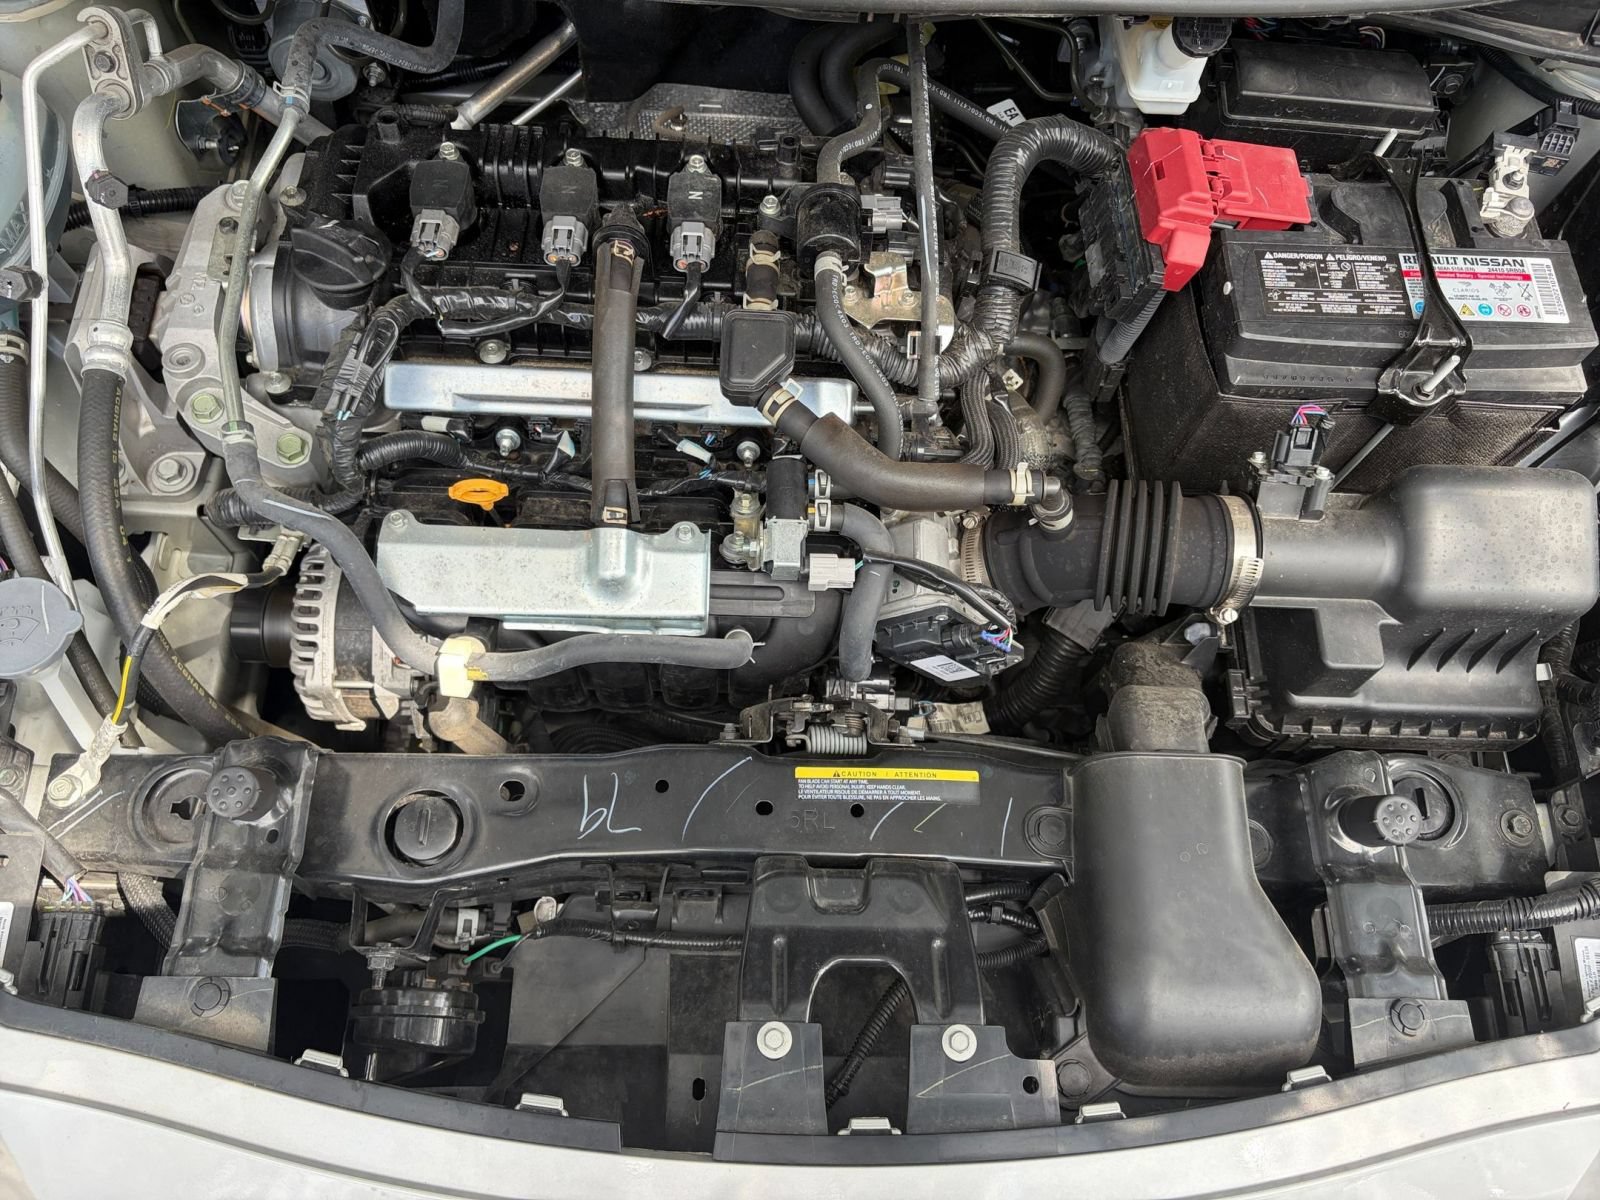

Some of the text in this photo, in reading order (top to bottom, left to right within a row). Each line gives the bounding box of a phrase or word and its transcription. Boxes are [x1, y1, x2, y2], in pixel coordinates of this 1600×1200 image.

[1003, 107, 1016, 121] EA
[1273, 252, 1323, 260] DANGER/POISON
[1463, 257, 1525, 268] NISSAN
[894, 771, 937, 779] ATTENTION
